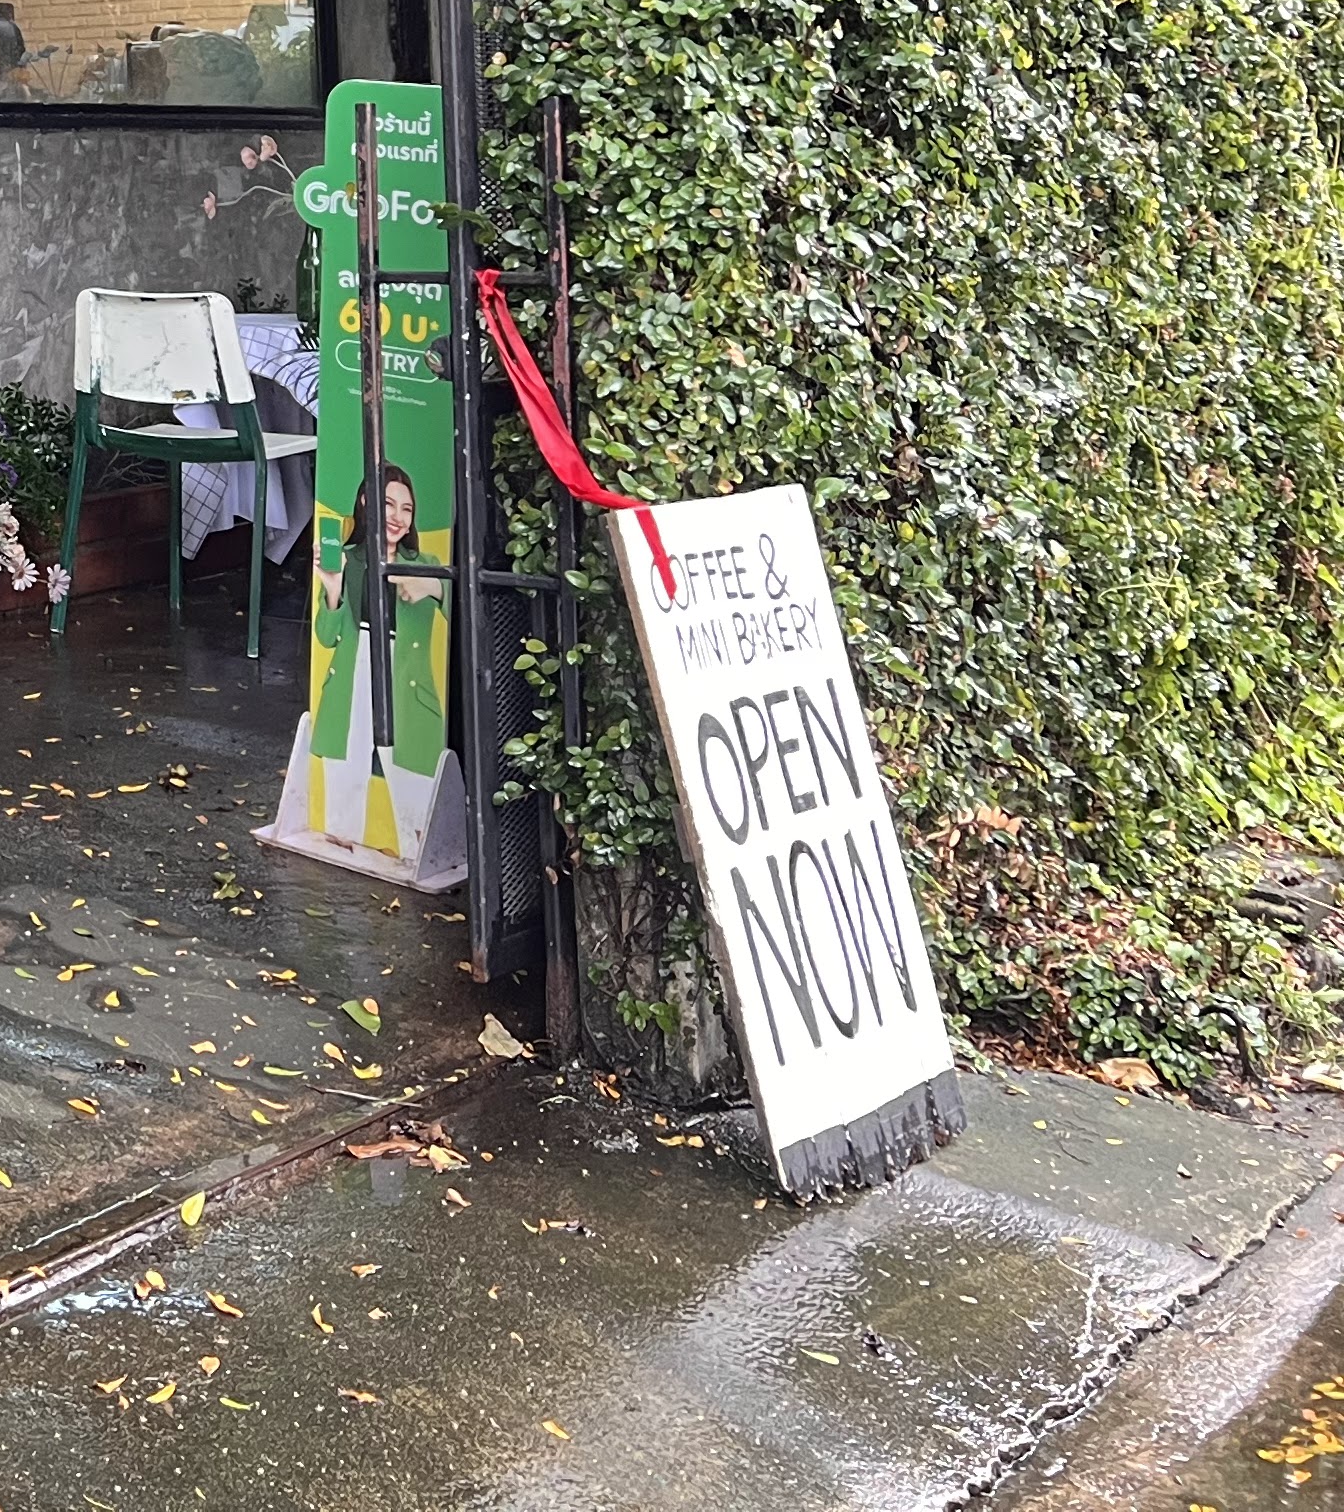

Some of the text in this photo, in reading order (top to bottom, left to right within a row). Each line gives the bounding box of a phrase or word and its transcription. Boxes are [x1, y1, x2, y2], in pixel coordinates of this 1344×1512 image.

[650, 533, 791, 614] COFFEE &
[675, 597, 823, 675] MINI BAKERY
[697, 678, 863, 846] OPEN
[730, 820, 918, 1067] NOW
